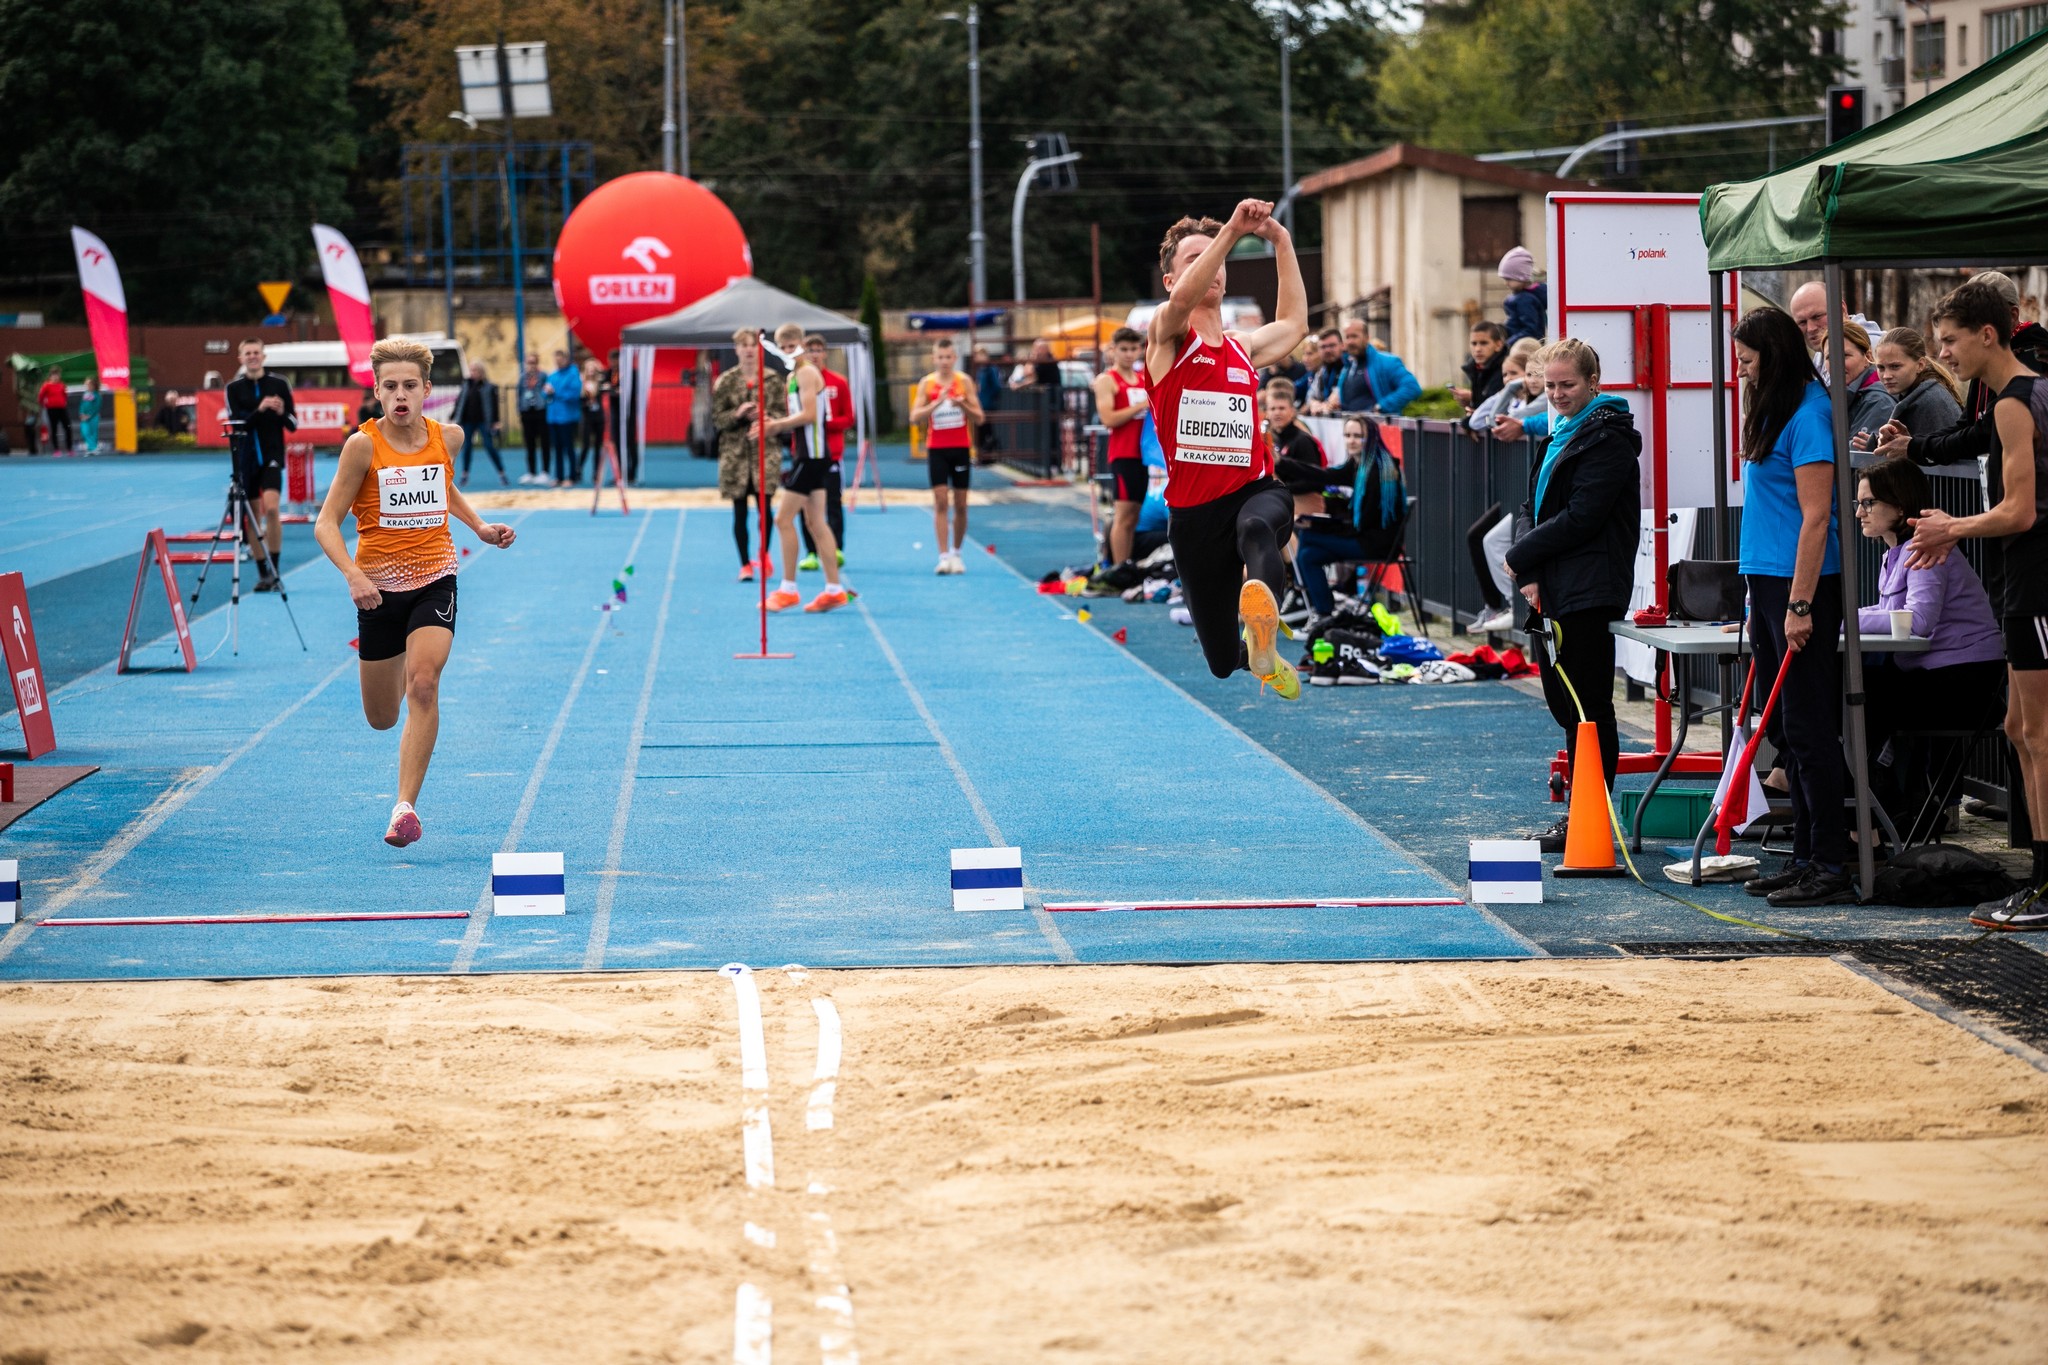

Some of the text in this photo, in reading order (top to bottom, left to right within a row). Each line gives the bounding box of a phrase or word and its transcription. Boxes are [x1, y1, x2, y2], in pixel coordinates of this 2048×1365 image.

[1637, 248, 1667, 260] polanik
[596, 282, 667, 298] ORLEN
[1191, 398, 1216, 406] Kraków
[1228, 396, 1247, 413] 30
[1183, 451, 1250, 464] KRAKÓW 2022
[421, 467, 439, 481] 17
[389, 490, 438, 506] SAMUL
[387, 517, 442, 526] KRAKÓW 2022
